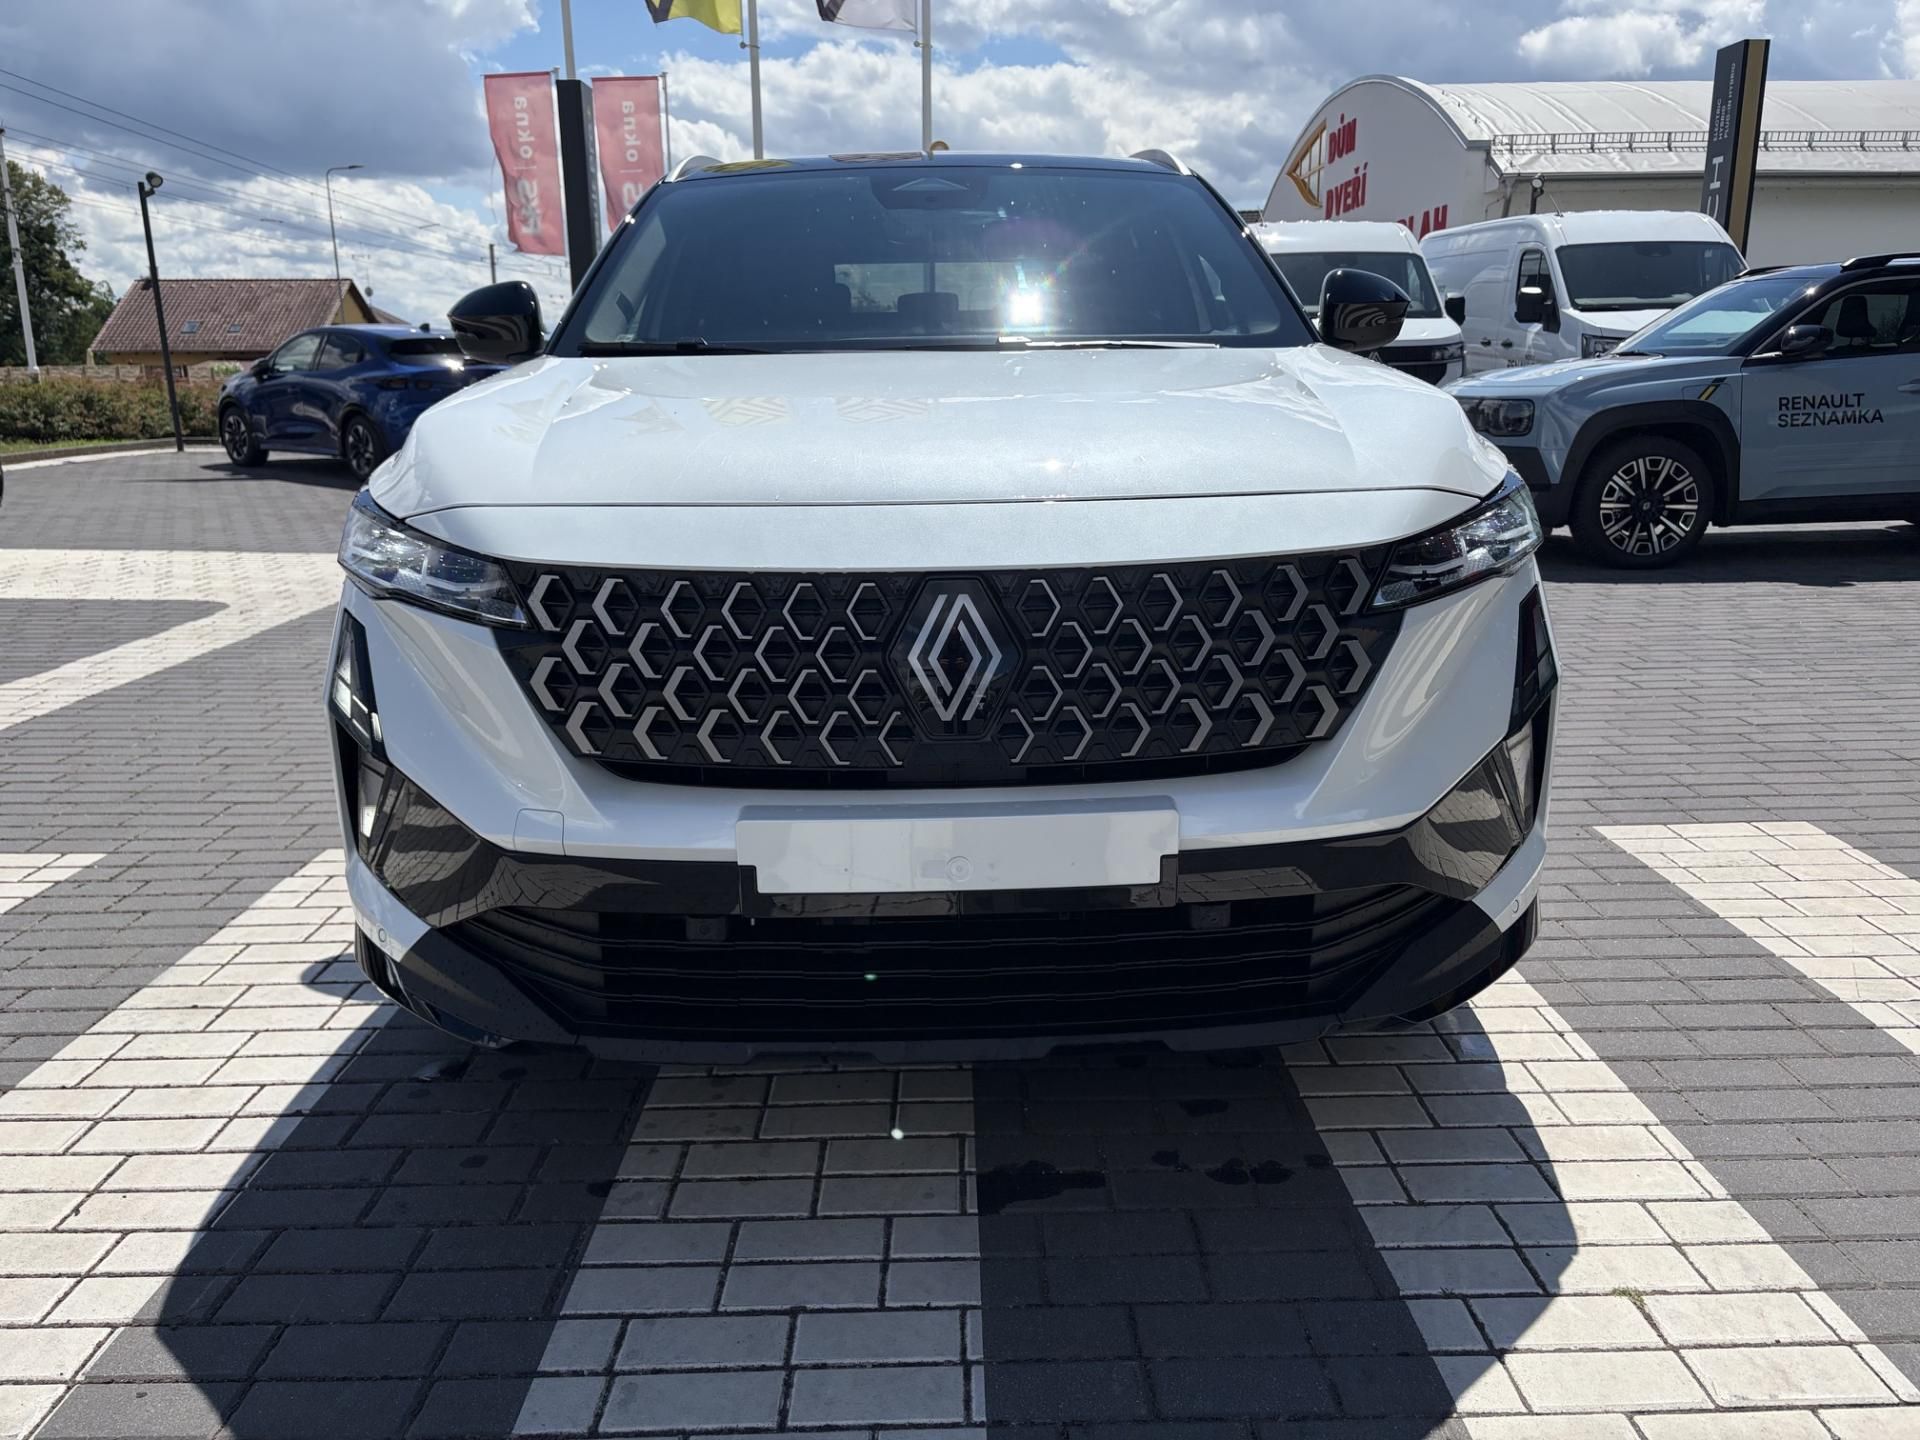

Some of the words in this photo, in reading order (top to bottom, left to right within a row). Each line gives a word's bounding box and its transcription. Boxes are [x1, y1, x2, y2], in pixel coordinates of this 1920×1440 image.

[1328, 113, 1357, 165] DŮM
[1325, 162, 1368, 220] DVEŘÍ
[1777, 409, 1884, 428] SEZNAMKA
[1778, 393, 1865, 411] RENAULT
